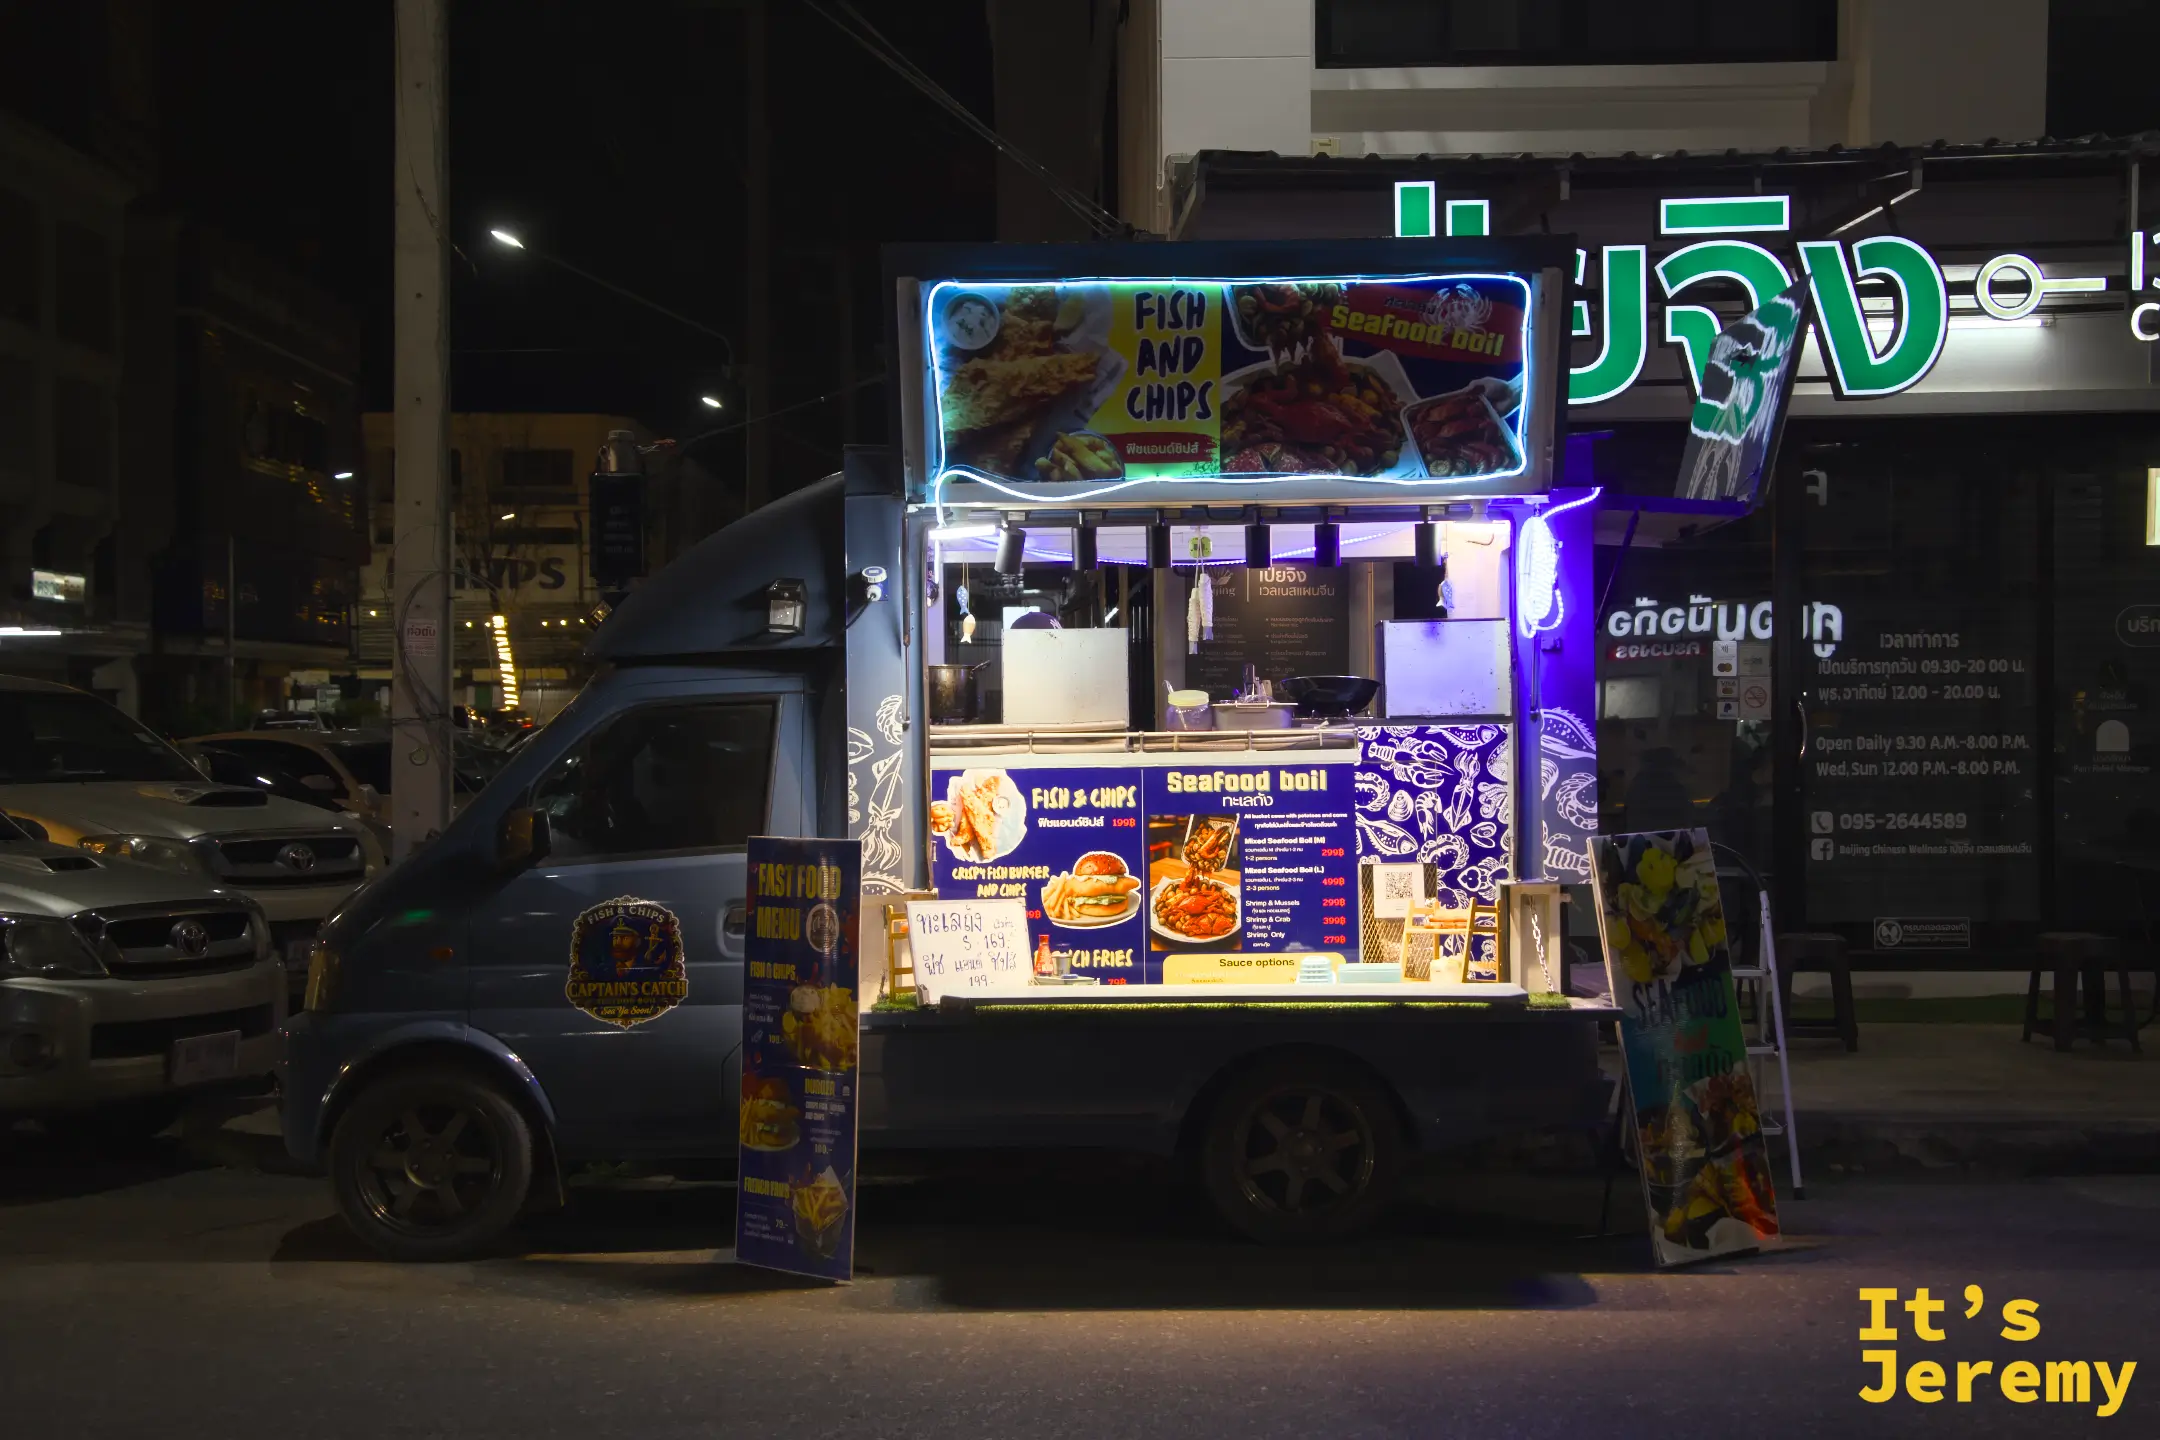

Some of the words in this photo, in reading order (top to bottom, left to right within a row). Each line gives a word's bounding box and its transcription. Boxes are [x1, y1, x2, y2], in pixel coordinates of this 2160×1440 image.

[1135, 290, 1206, 330] FISH
[1330, 304, 1444, 346] Seafood
[1452, 326, 1504, 356] boil
[1136, 334, 1204, 378] AND
[1126, 380, 1214, 422] CHIPS
[1126, 442, 1199, 455] ฟิชแอนด์ชิปส์
[1880, 629, 1960, 649] เวลาทำการ
[1818, 657, 1916, 679] เปิดบริการทุกวัน
[1892, 685, 1927, 700] 12.00
[1944, 684, 1984, 700] 20.00
[1816, 736, 1852, 754] Open
[1856, 734, 1891, 756] Daily
[1896, 736, 1926, 750] 9.30
[2002, 734, 2030, 749] P.M.
[1882, 762, 1918, 776] 12.00
[1993, 760, 2020, 774] P.M.
[1167, 770, 1271, 793] Seafood
[1279, 769, 1328, 792] boil
[1031, 786, 1070, 810] FISH
[1074, 788, 1088, 809] &
[1090, 785, 1137, 809] CHIPS
[1038, 816, 1105, 828] ฟิชแอนด์ชิปส์
[1112, 818, 1136, 828] 199฿
[1839, 812, 1968, 830] 095-2644589
[1299, 836, 1313, 844] Boil
[1322, 848, 1345, 857] 299฿
[757, 863, 794, 897] FAST
[797, 865, 842, 899] FOOD
[952, 866, 986, 880] CRISPY
[987, 866, 1008, 880] FISH
[1009, 866, 1050, 880] BURGER
[977, 884, 999, 898] AND
[1000, 882, 1028, 897] CHIPS
[1322, 898, 1346, 907] 299฿
[588, 908, 614, 925] FISH
[617, 906, 625, 914] &
[628, 906, 664, 923] CHIPS
[756, 906, 800, 941] MENU
[1323, 916, 1346, 926] 399฿
[1323, 936, 1346, 944] 279฿
[1093, 948, 1133, 968] FRIES
[1220, 958, 1252, 967] Sauce
[1256, 958, 1294, 968] options
[569, 981, 639, 997] CAPTAIN'S
[642, 981, 686, 996] CATCH
